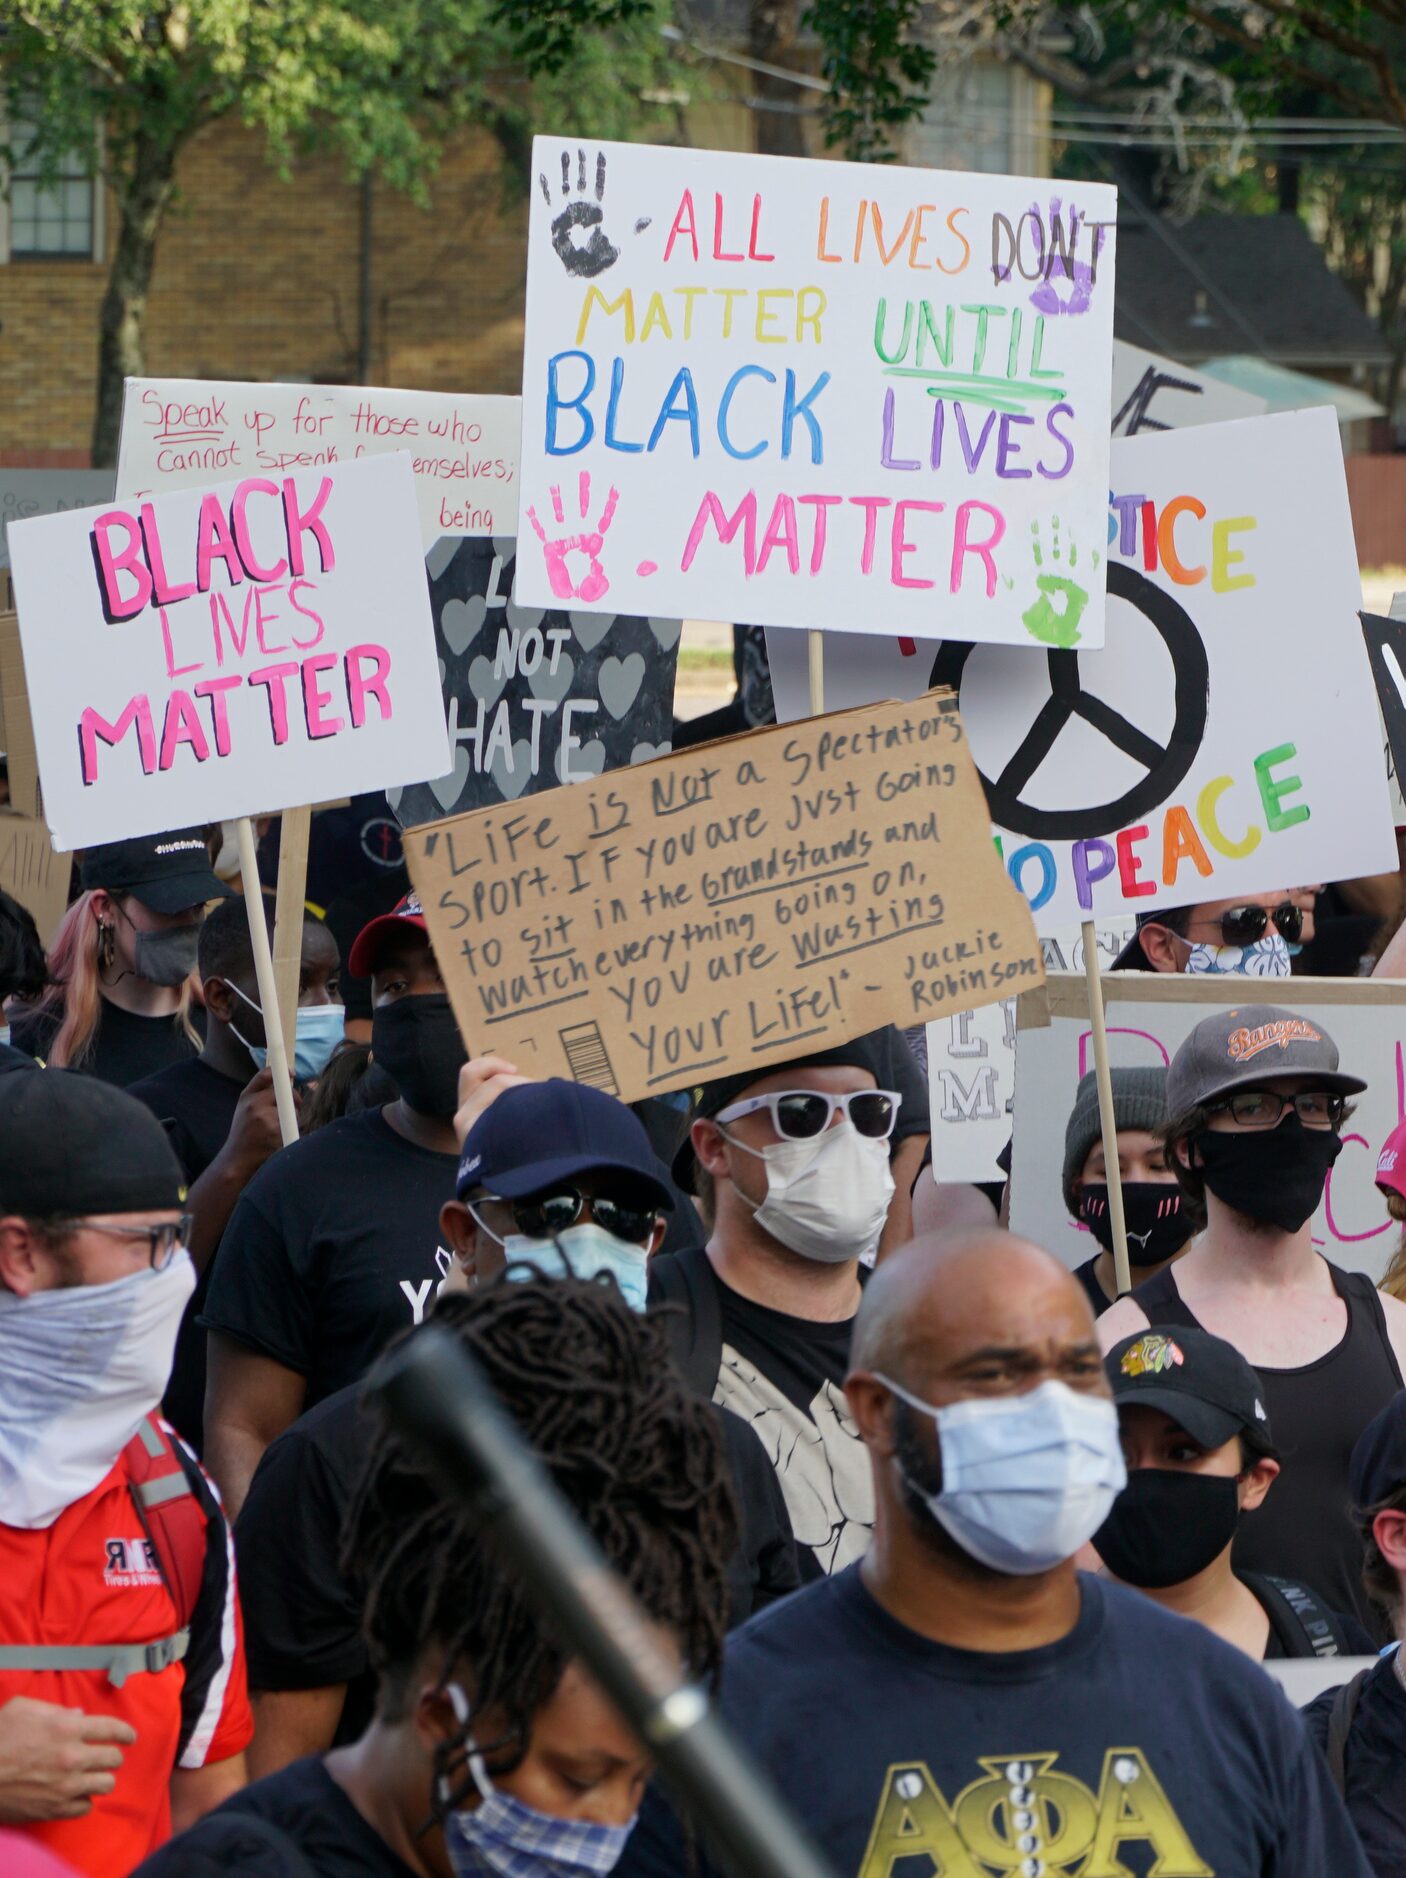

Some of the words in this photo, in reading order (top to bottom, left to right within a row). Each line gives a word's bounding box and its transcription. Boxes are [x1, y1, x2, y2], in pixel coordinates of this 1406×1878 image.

[663, 188, 775, 263] ALL
[817, 197, 971, 275] LIVES
[575, 286, 827, 344] MATTER
[874, 298, 1064, 379] UNTIL
[142, 390, 229, 435] Speak
[244, 410, 276, 446] up
[292, 397, 334, 436] for
[350, 402, 420, 438] those
[427, 410, 482, 443] who
[545, 350, 831, 465] BLACK
[881, 387, 1075, 480] LIVES
[411, 454, 516, 483] emselves;
[90, 476, 336, 624] BLACK
[439, 496, 494, 535] being
[681, 489, 1008, 598] MATTER
[1108, 492, 1259, 593] TICE
[159, 578, 326, 678] LIVES
[493, 628, 571, 680] NOT
[77, 643, 394, 786] MATTER
[448, 697, 599, 784] HATE
[652, 767, 721, 814] Not
[737, 760, 767, 786] a
[706, 807, 768, 849] are
[1072, 741, 1311, 910] PEACE
[461, 939, 501, 976] to
[521, 915, 574, 955] sit
[594, 899, 628, 930] in
[641, 884, 694, 916] the
[885, 812, 942, 844] and
[707, 938, 779, 983] are
[792, 893, 946, 962] Wasting
[595, 911, 755, 976] everything
[911, 956, 1038, 1014] Robinson
